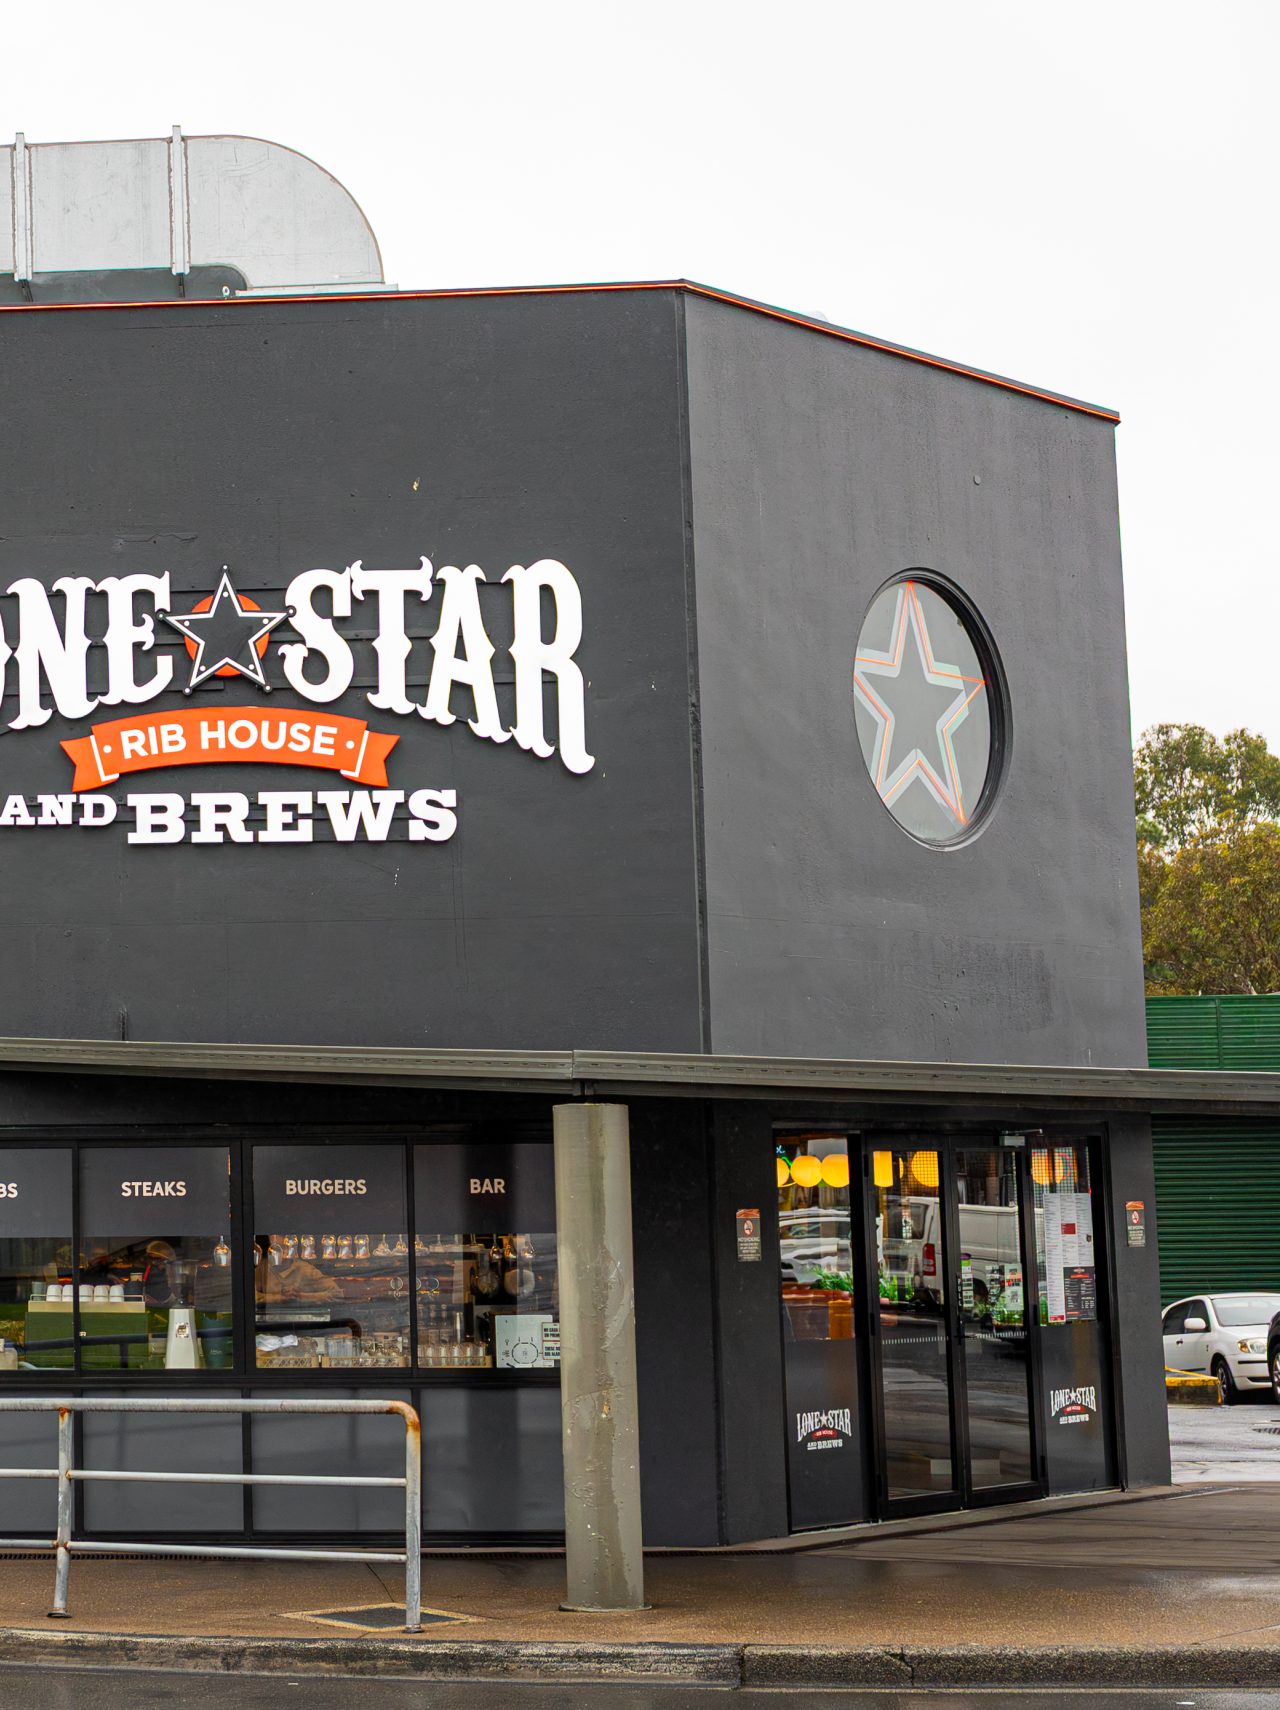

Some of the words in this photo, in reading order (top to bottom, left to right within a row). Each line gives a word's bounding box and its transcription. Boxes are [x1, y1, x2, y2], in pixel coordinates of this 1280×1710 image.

[278, 555, 596, 774] STAR
[120, 724, 187, 760] RIB
[200, 719, 338, 756] HOUSE
[127, 788, 458, 845] BREWS
[121, 1181, 187, 1198] STEAKS
[285, 1179, 368, 1196] BURGERS
[470, 1178, 507, 1194] BAR
[1050, 1388, 1070, 1417] LONE
[1076, 1385, 1096, 1412] STAR
[796, 1411, 820, 1442] LONE
[827, 1408, 852, 1437] STAR
[817, 1438, 843, 1450] BREWS
